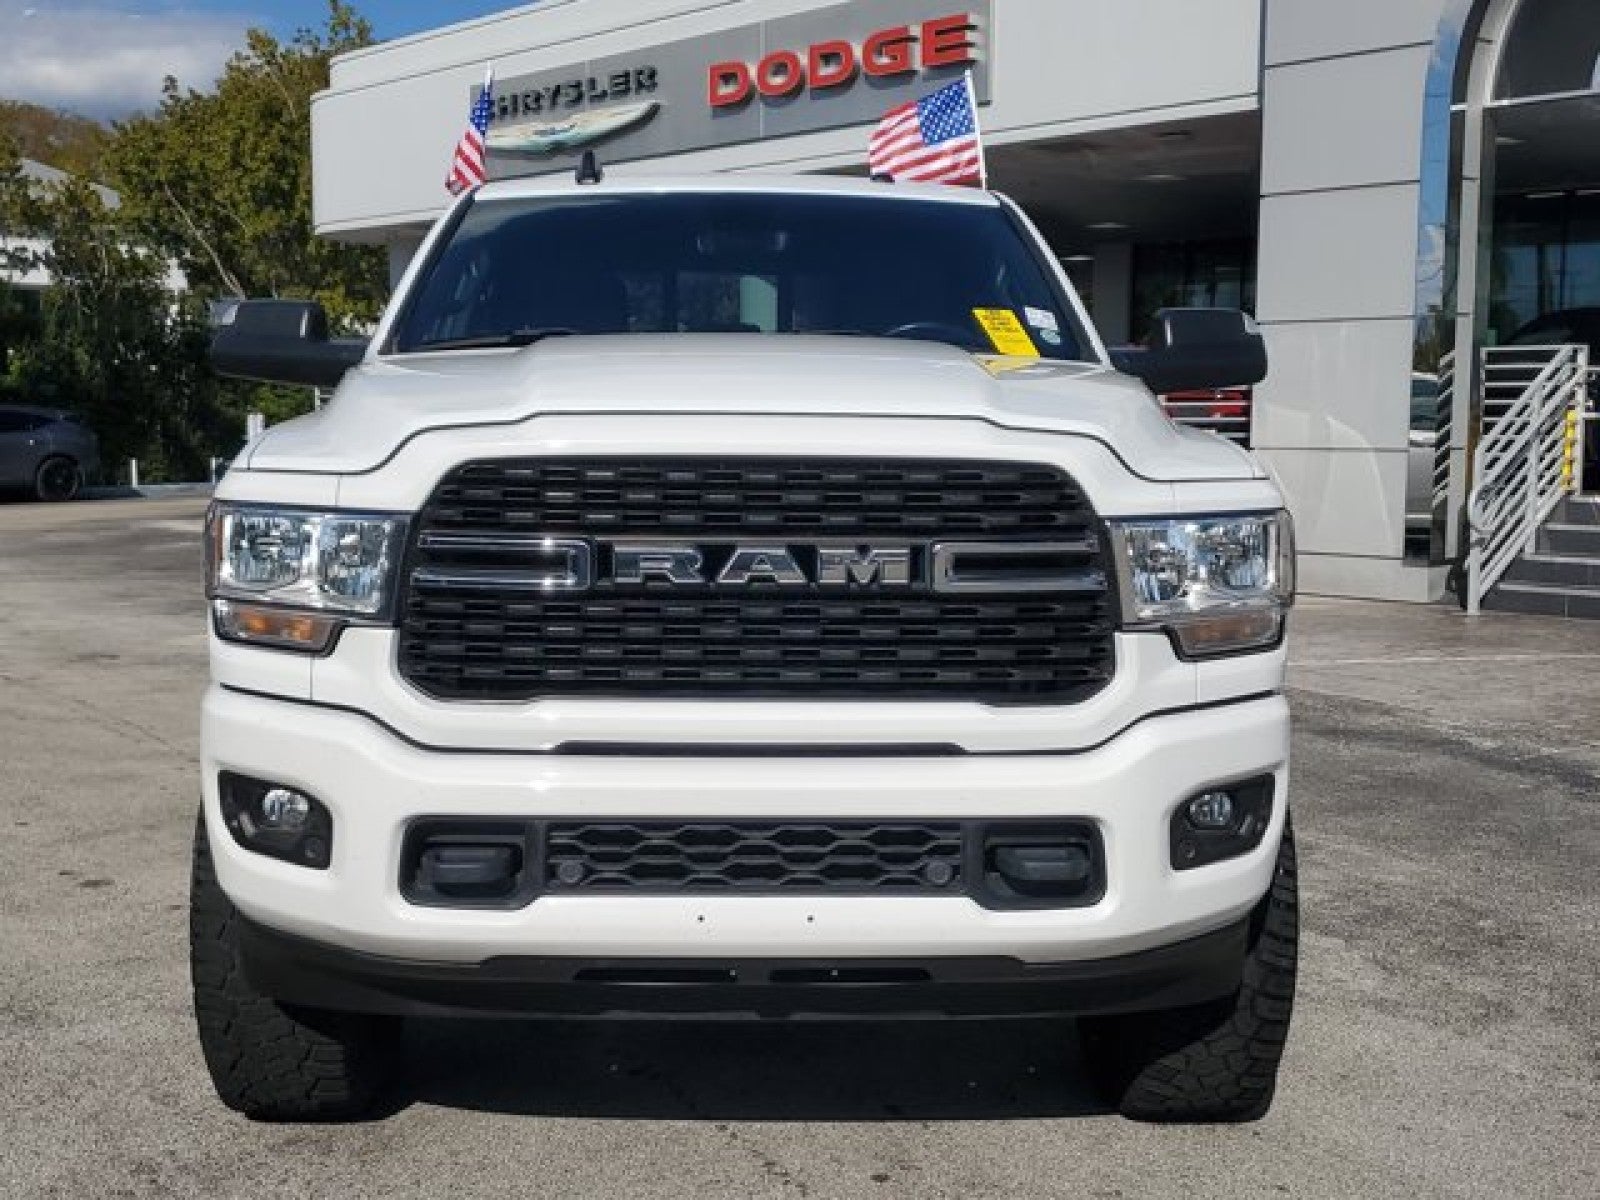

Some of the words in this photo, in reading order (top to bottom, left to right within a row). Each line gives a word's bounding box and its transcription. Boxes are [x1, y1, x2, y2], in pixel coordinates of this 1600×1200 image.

[708, 13, 970, 107] DODGE
[488, 65, 658, 121] HRYSLER
[612, 545, 910, 584] RAM
